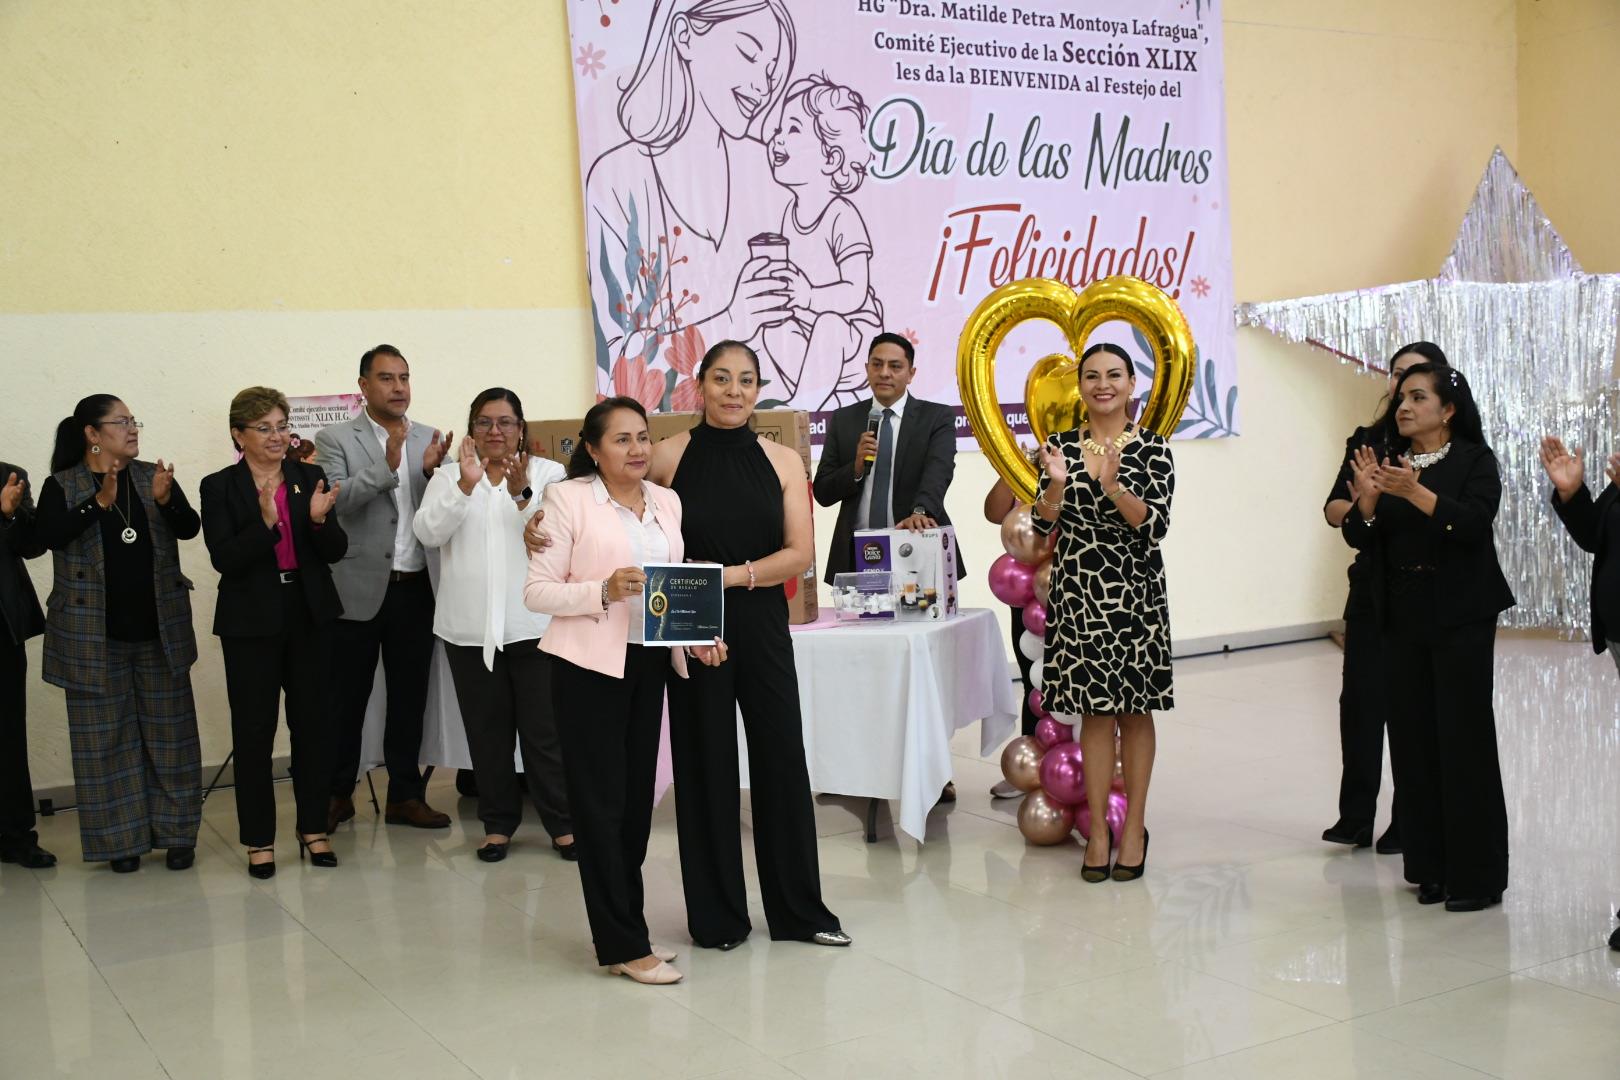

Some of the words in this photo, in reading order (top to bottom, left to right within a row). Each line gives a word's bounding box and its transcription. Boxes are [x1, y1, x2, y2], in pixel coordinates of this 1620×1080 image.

[858, 0, 885, 13] HG
[889, 0, 936, 18] "Dra.
[941, 2, 1007, 24] Matilde
[1012, 8, 1055, 28] Petra
[1060, 12, 1129, 38] Montoya
[1132, 19, 1209, 44] Lafragua",
[874, 32, 936, 52] Comité
[940, 36, 1017, 59] Ejecutivo
[1021, 43, 1040, 61] de
[1044, 44, 1058, 62] la
[1062, 41, 1141, 68] Sección
[1145, 47, 1198, 72] XLIX
[896, 62, 921, 82] les
[925, 64, 945, 83] da
[949, 66, 965, 84] la
[970, 68, 1082, 92] BIENVENIDA
[1085, 76, 1100, 93] al
[1103, 77, 1156, 100] Festejo
[1160, 80, 1182, 98] del
[868, 98, 957, 180] Día
[966, 112, 1010, 177] de
[1018, 115, 1072, 180] las
[1084, 112, 1212, 191] Madres
[928, 203, 1195, 301] ¡Felicidades!
[809, 418, 827, 435] ad
[669, 578, 708, 586] CERTIFICADO
